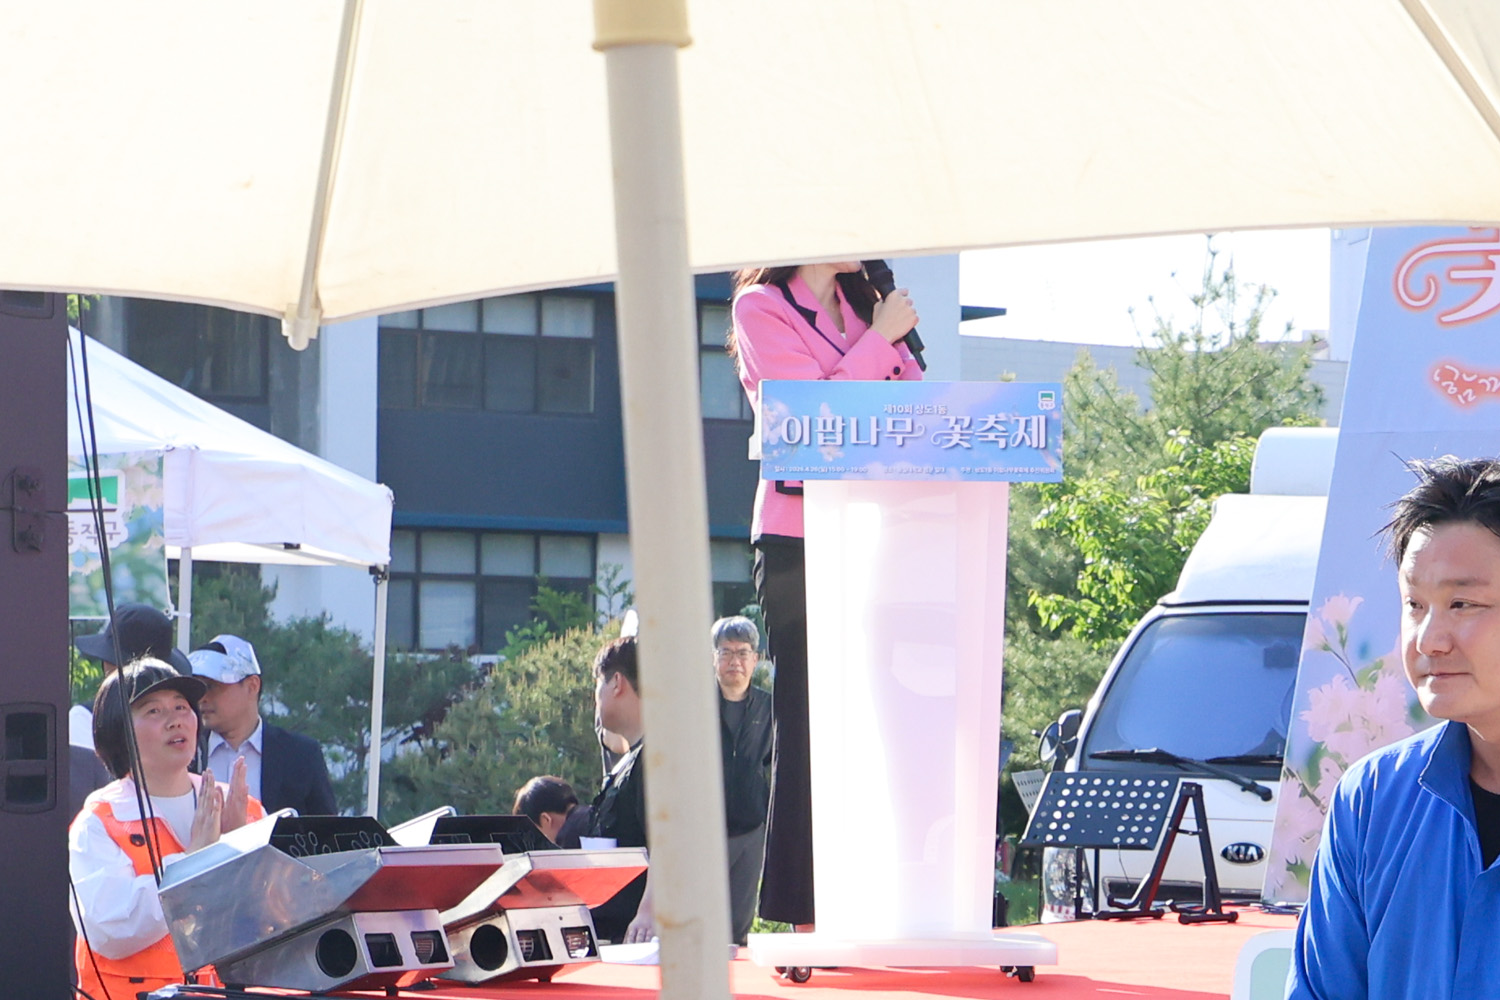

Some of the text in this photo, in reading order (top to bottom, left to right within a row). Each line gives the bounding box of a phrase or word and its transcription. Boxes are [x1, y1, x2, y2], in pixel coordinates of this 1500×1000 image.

[883, 403, 948, 415] 제10회 상도1동
[781, 414, 1047, 450] 이팝나무 꽃축제
[1226, 844, 1259, 861] KIA
